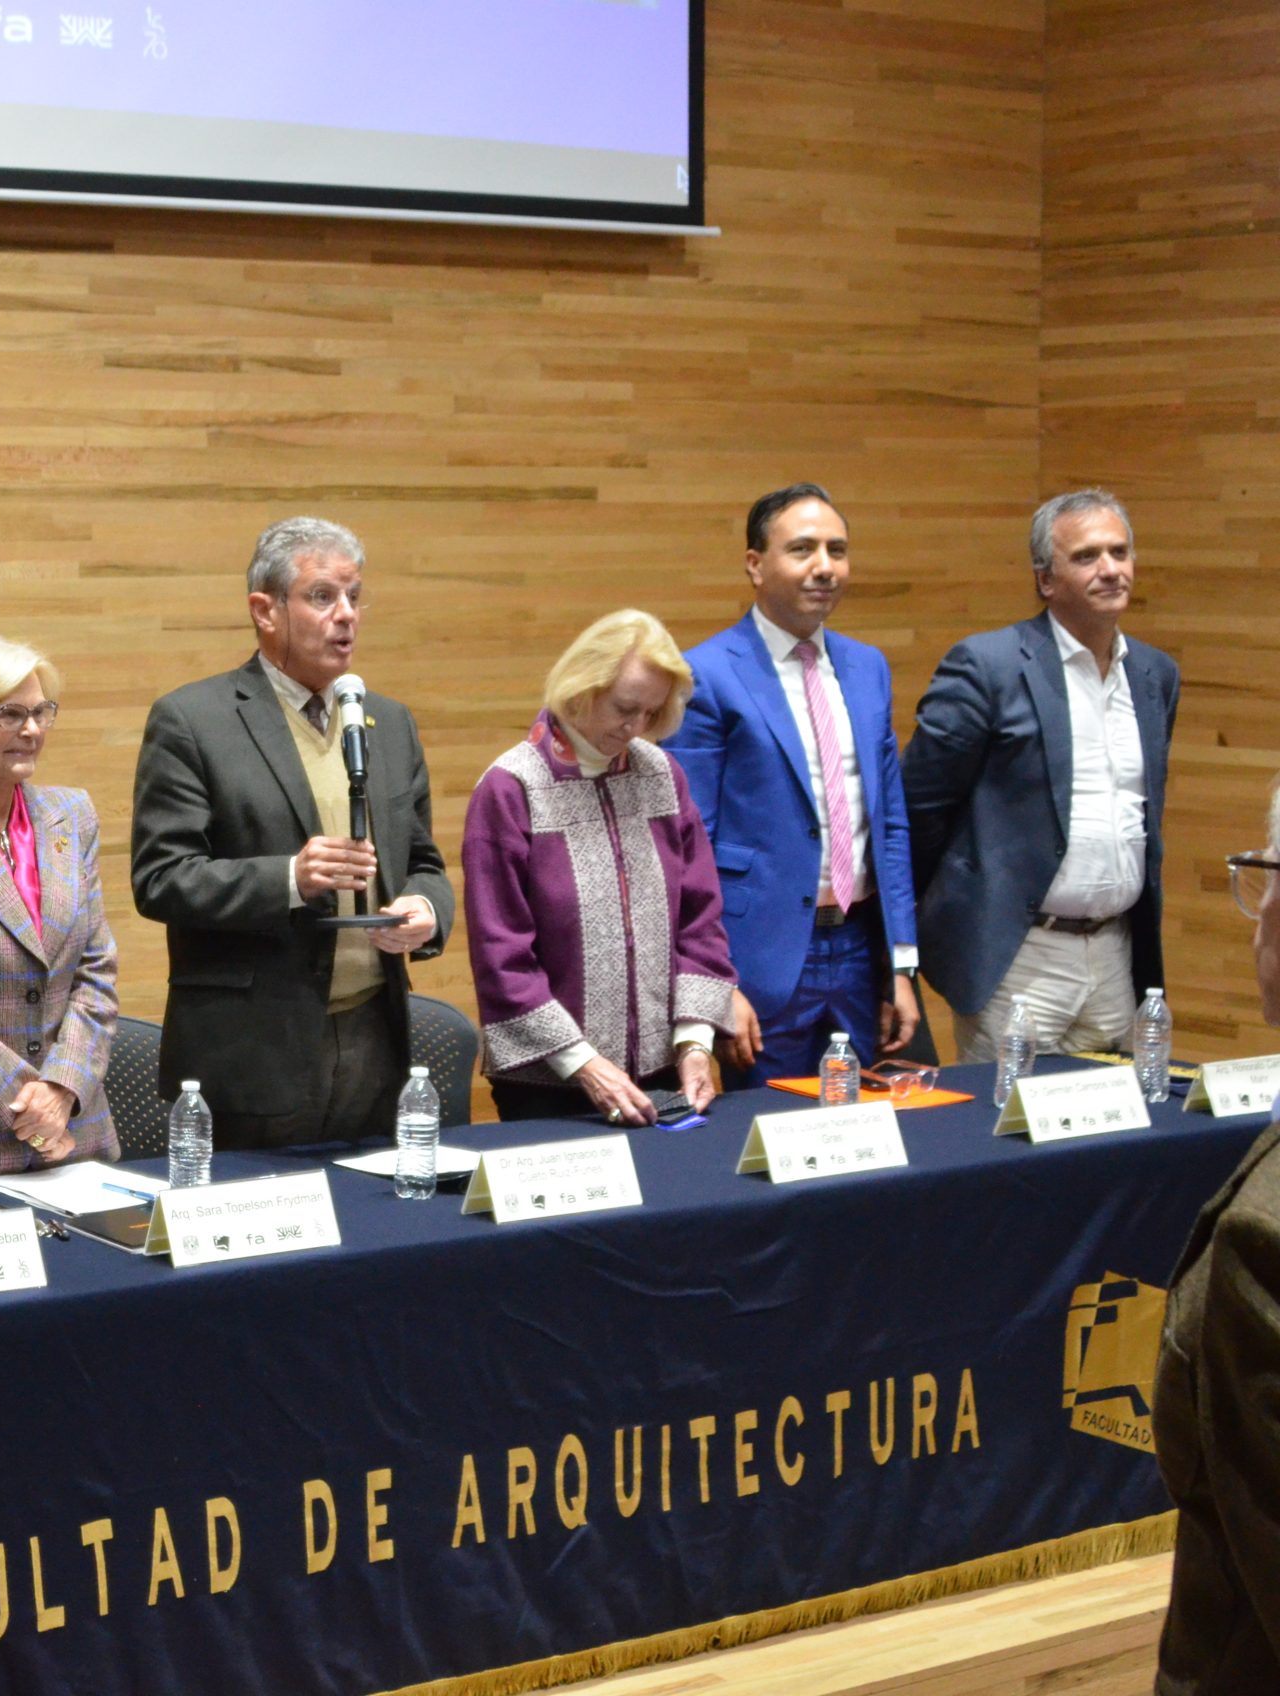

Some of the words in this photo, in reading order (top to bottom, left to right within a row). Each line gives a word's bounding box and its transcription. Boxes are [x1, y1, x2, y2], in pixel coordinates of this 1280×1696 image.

[196, 1205, 222, 1217] Sara
[224, 1198, 274, 1214] Topelson
[276, 1192, 324, 1209] Frydman
[559, 1191, 577, 1204] fa
[246, 1233, 266, 1246] fa
[1081, 1410, 1152, 1445] FACULTAD
[303, 1468, 395, 1574] DE
[451, 1368, 980, 1548] ARQUITECTURA
